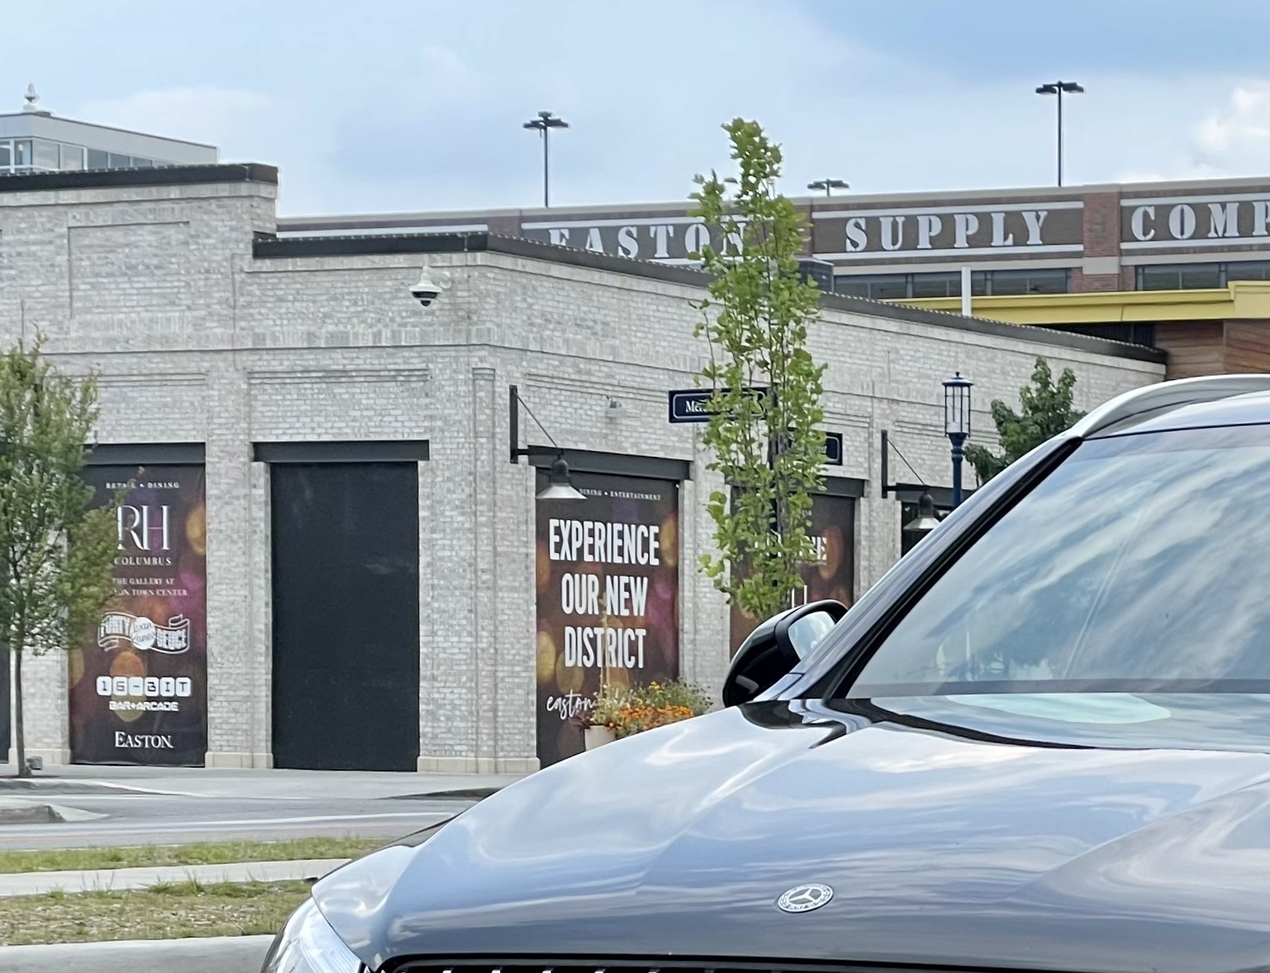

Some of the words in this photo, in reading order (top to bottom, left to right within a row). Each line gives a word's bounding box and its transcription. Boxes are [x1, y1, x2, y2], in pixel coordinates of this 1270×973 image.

[845, 210, 1049, 252] SUPPLY
[610, 490, 661, 501] ENTERTAINMENT
[117, 505, 171, 551] RH
[549, 518, 660, 566] EXPERIENCE
[114, 557, 172, 566] COLUMBUS
[129, 577, 162, 585] GALLERY
[165, 577, 175, 585] AT
[132, 589, 154, 597] TOWN
[156, 589, 188, 597] CENTER
[561, 573, 600, 616] OUR
[605, 575, 648, 617] NEW
[564, 626, 647, 669] DISTRICT
[100, 679, 189, 694] 16-BIT
